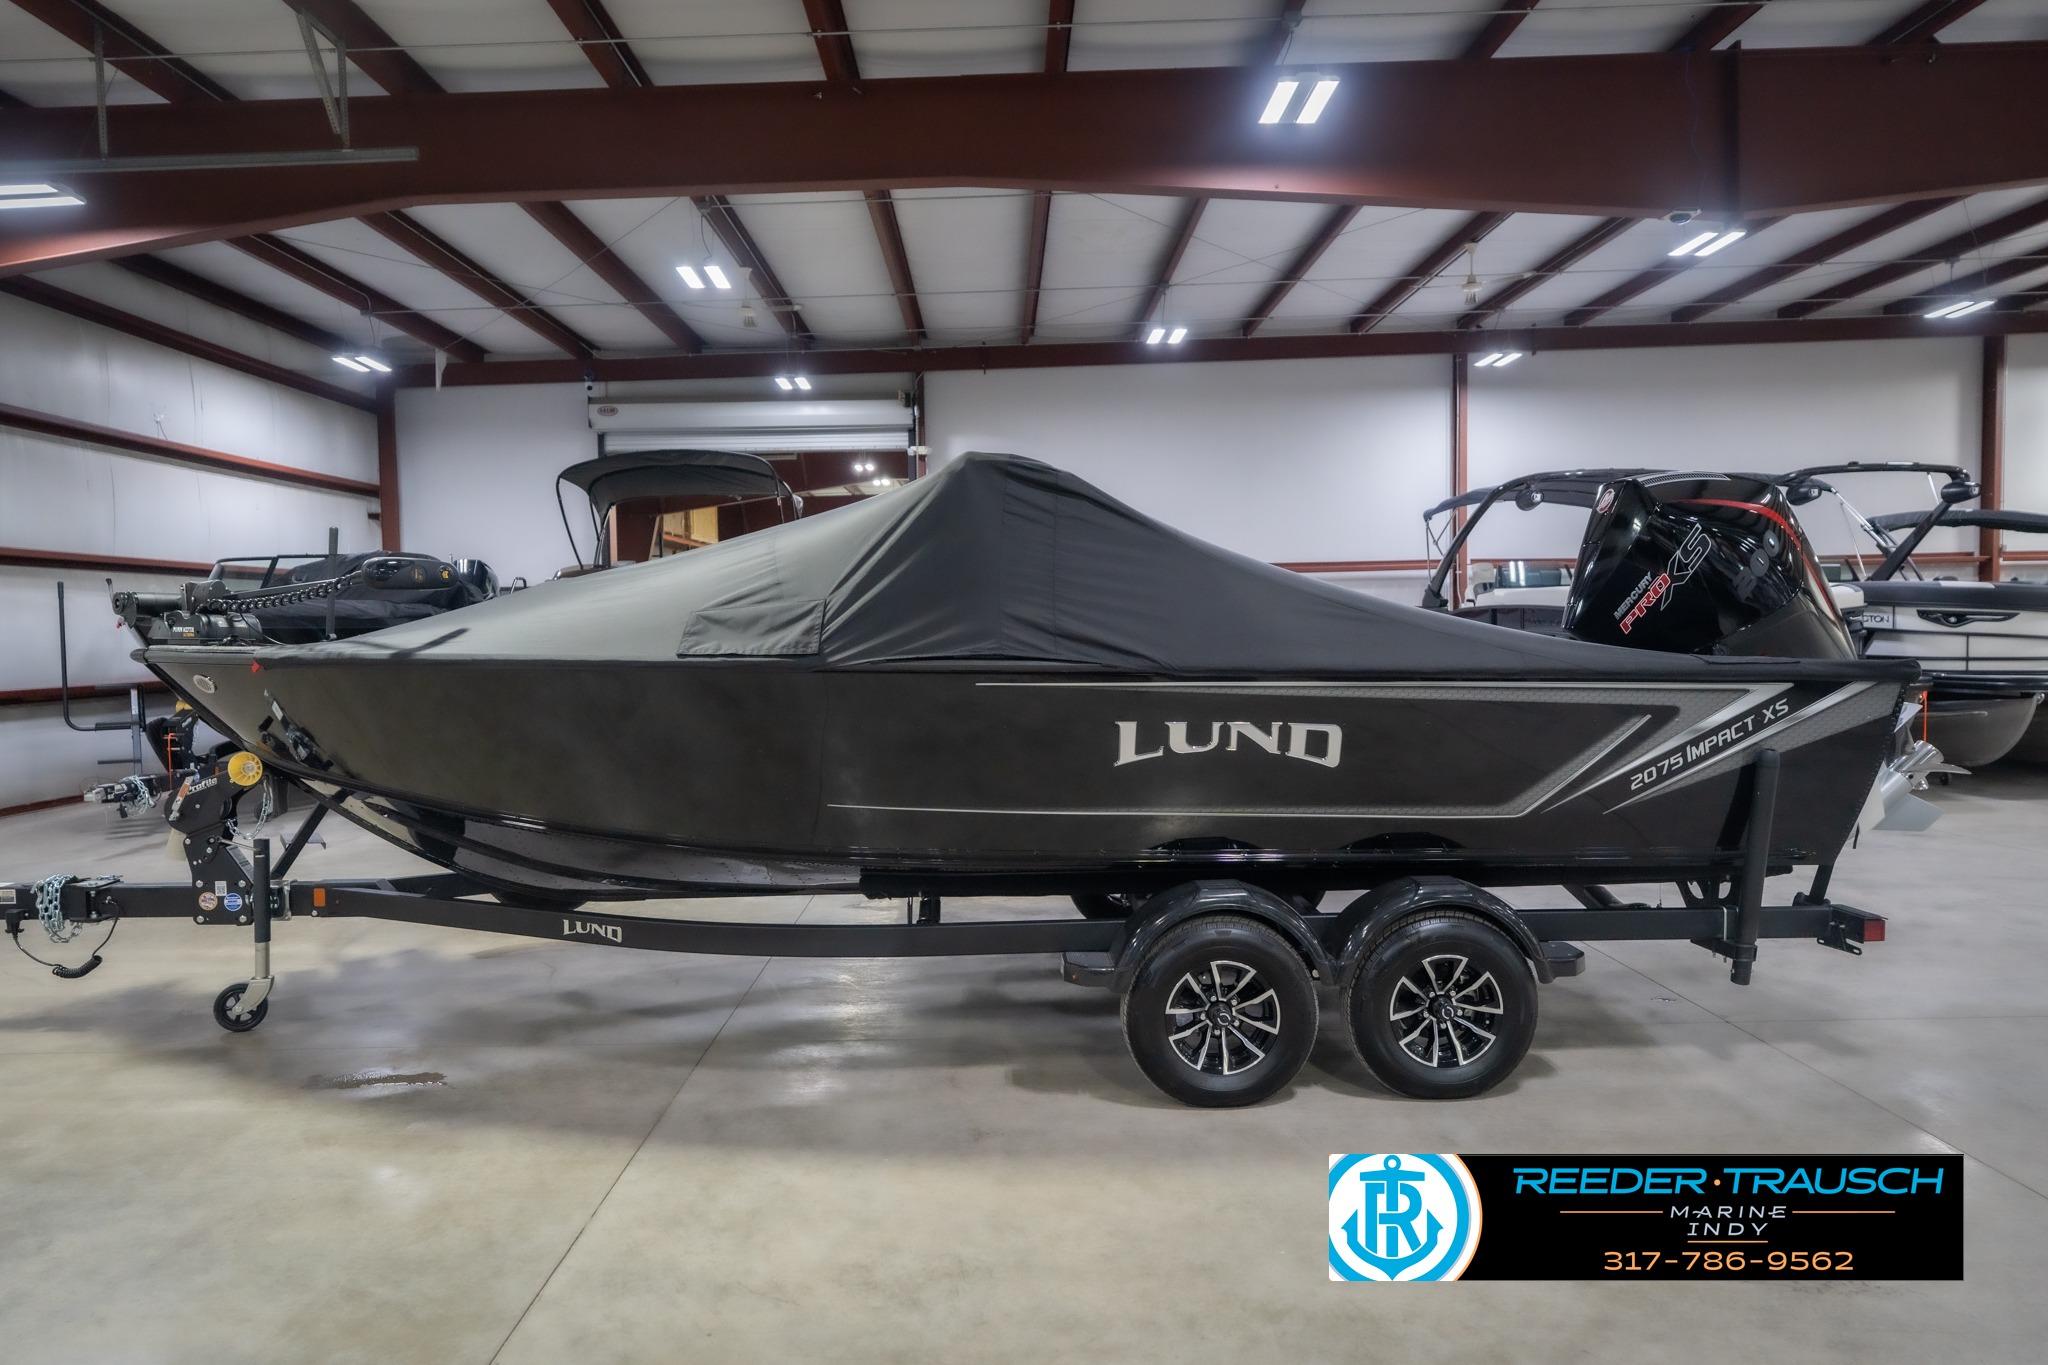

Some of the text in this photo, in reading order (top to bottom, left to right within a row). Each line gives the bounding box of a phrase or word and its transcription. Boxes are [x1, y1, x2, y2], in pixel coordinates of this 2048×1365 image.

[1613, 570, 1653, 620] MERCURY
[1619, 523, 1711, 634] PRO XS
[1113, 720, 1343, 768] LUND
[1630, 698, 1790, 791] 2075 IMPACT XS
[563, 919, 623, 943] LUND
